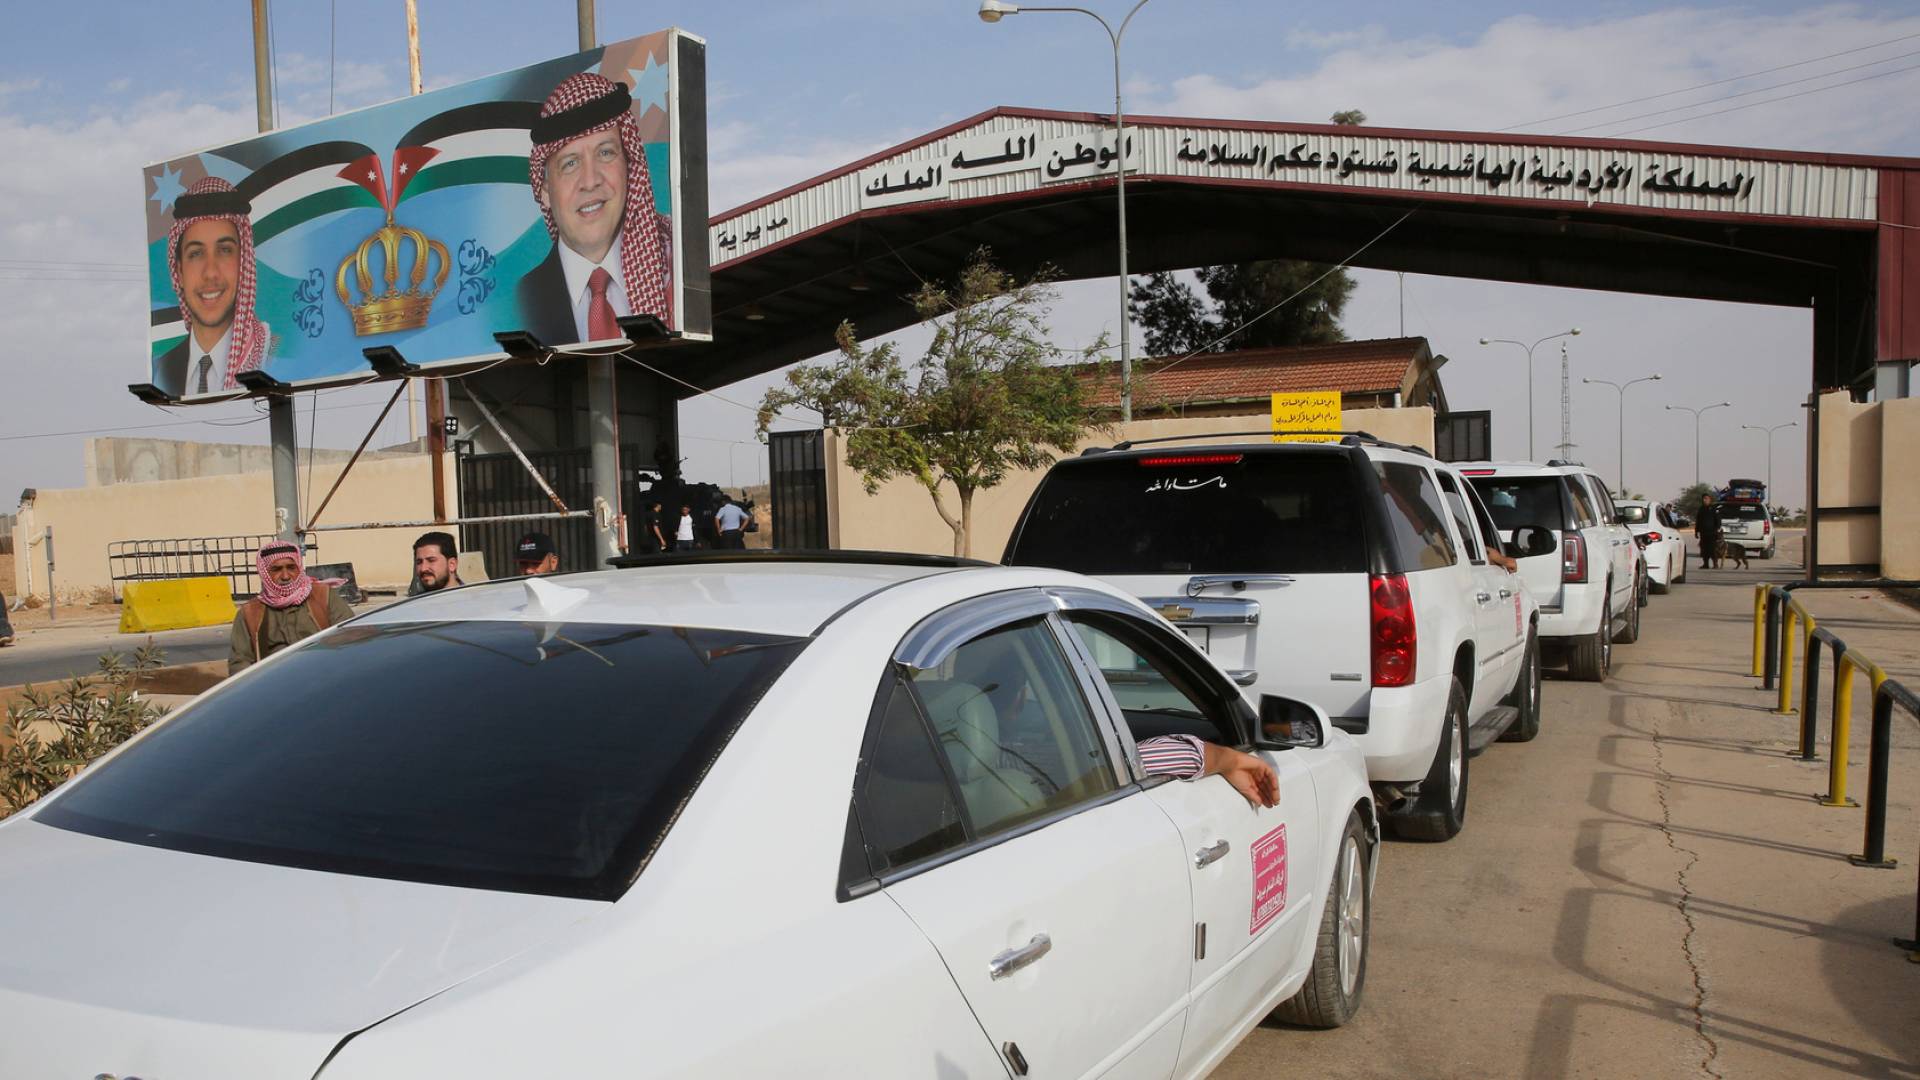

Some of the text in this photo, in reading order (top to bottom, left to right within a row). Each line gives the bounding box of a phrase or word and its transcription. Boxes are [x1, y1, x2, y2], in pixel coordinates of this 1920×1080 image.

[1046, 135, 1132, 178] الوطن
[1177, 137, 1267, 167] السلامة
[1269, 142, 1398, 178] تستودعكم
[1408, 151, 1526, 189] الهاشمية
[865, 164, 942, 197] الملك
[1641, 163, 1756, 199] المملكة
[717, 217, 788, 250] مديرية
